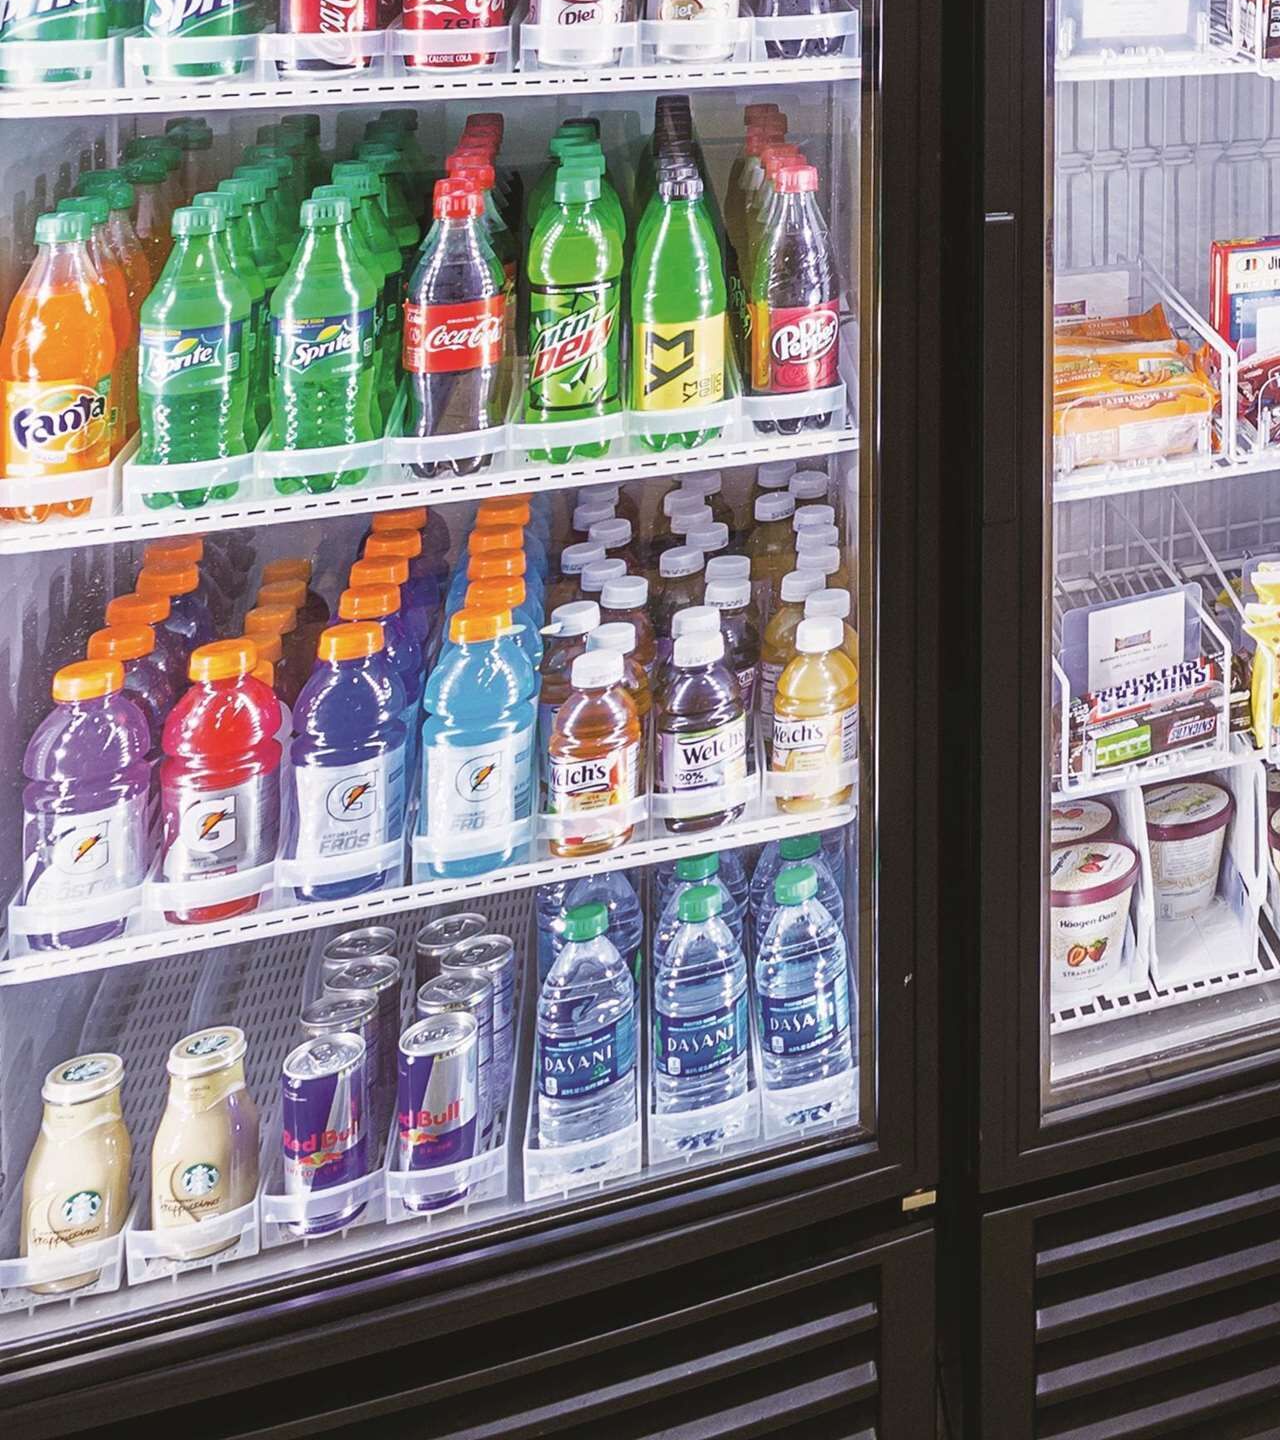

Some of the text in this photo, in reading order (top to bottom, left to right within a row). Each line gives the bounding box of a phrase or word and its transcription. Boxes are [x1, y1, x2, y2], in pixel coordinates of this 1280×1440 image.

[565, 8, 597, 25] Diet
[540, 310, 590, 351] Mtn
[800, 318, 824, 342] Dr
[535, 317, 610, 375] DEW
[12, 394, 107, 451] Fanta
[682, 727, 744, 766] Welch's
[667, 1025, 734, 1053] DASANI
[544, 1045, 613, 1074] DASANI
[417, 1100, 461, 1129] Bull
